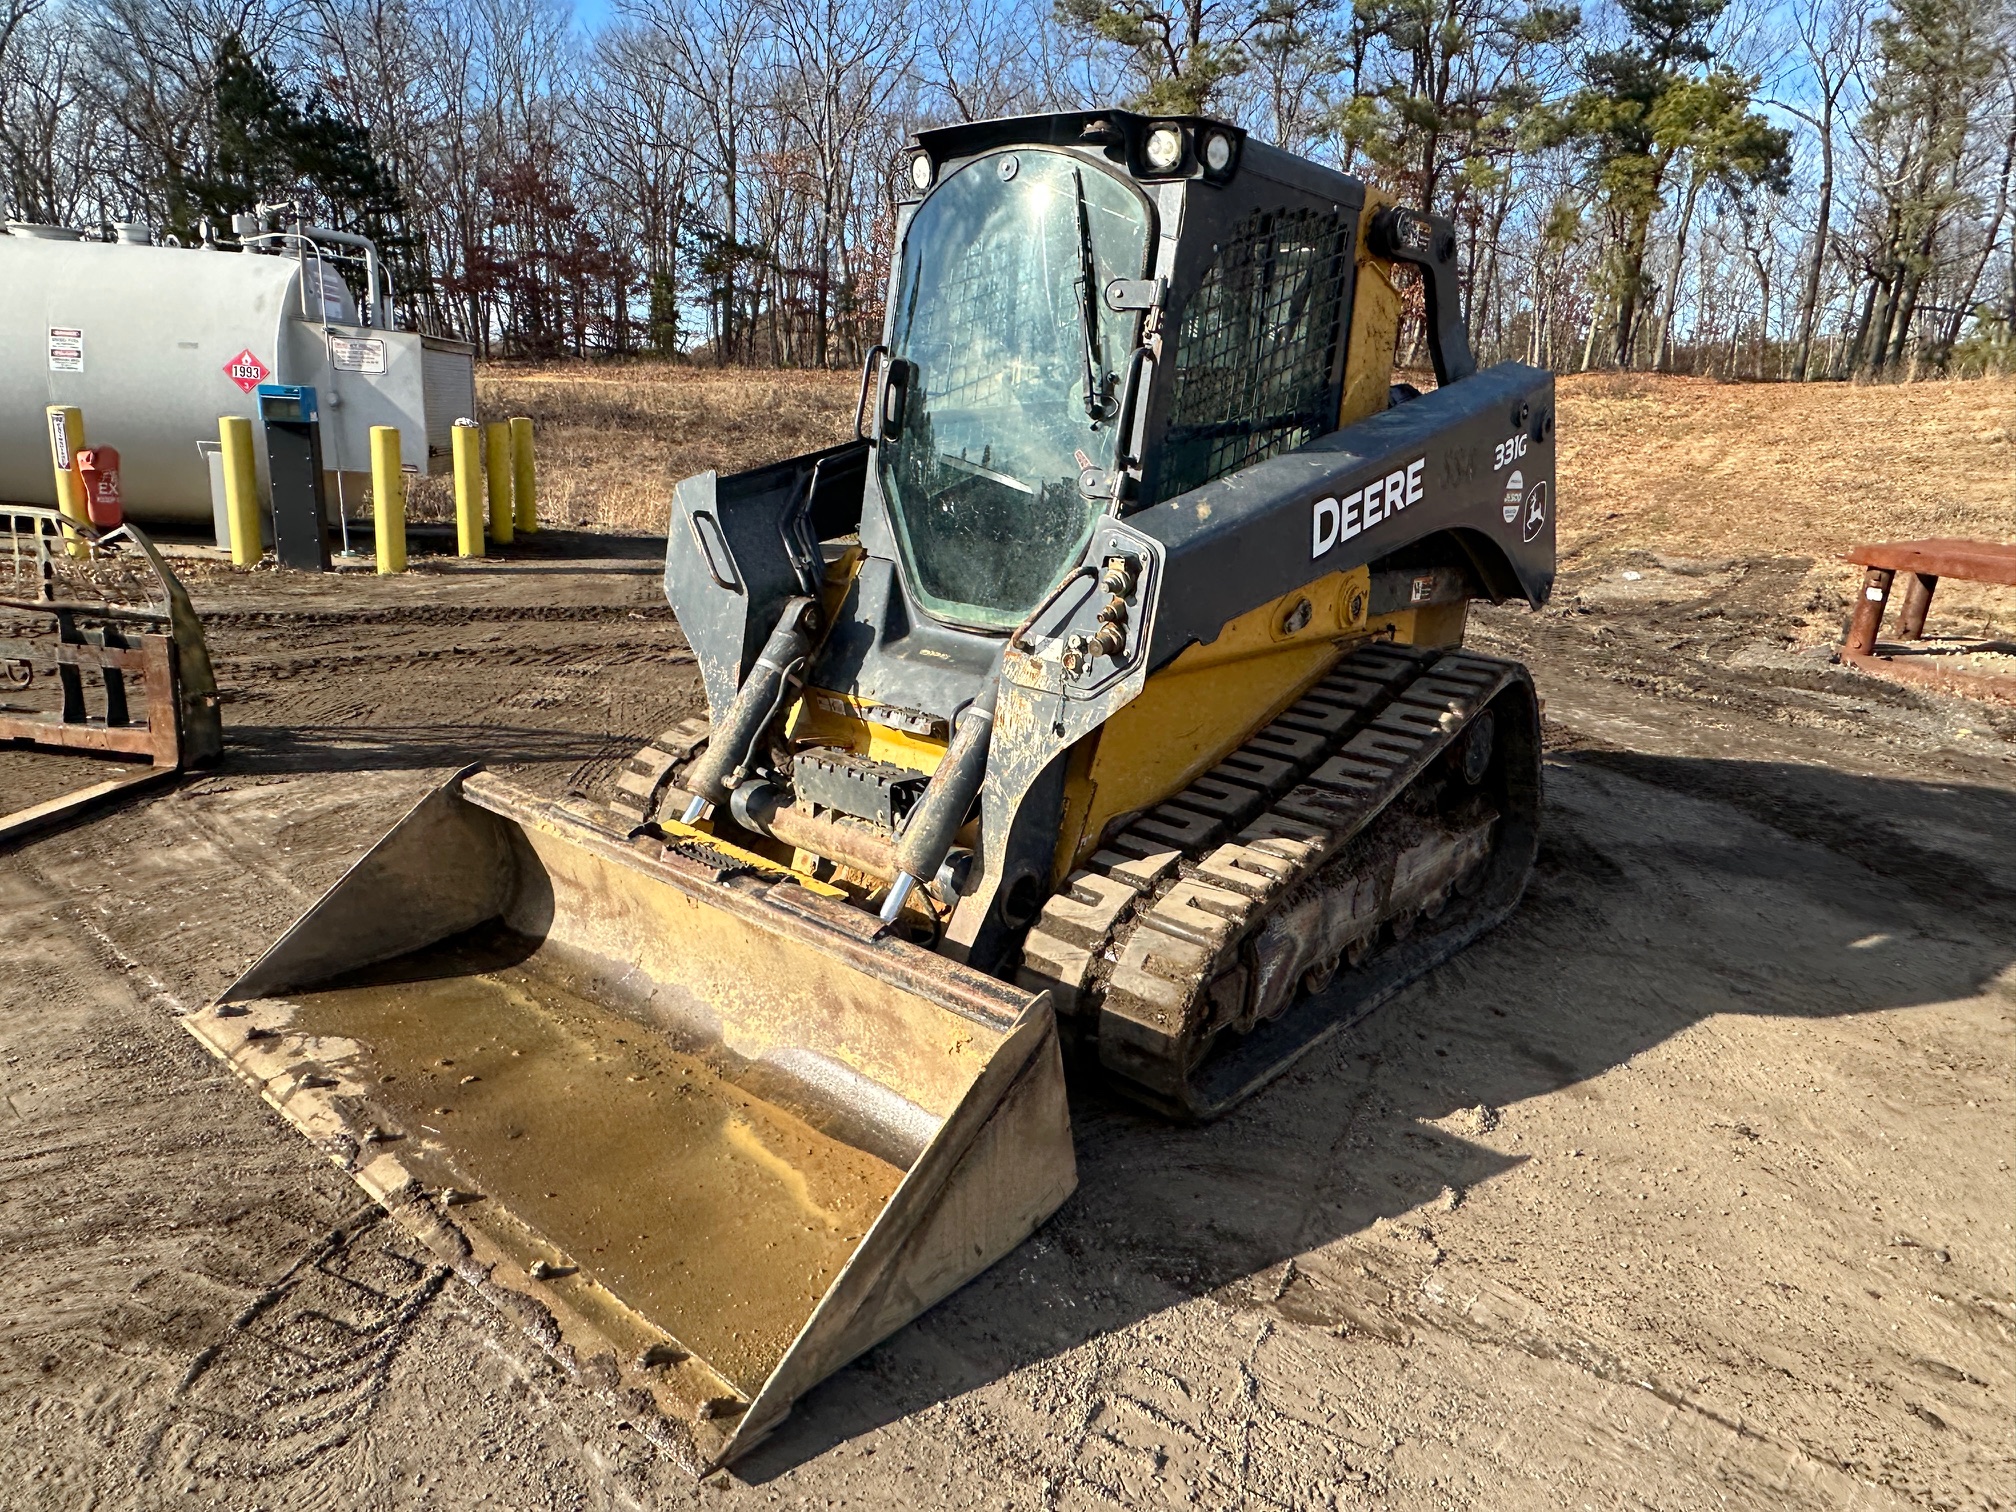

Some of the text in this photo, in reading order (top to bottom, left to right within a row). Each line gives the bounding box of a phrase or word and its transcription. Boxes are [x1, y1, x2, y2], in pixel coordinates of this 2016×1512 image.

[233, 366, 259, 379] 1993
[243, 382, 249, 390] 3
[1493, 433, 1528, 471] 331G
[98, 482, 119, 495] EX
[1312, 457, 1426, 559] DEERE
